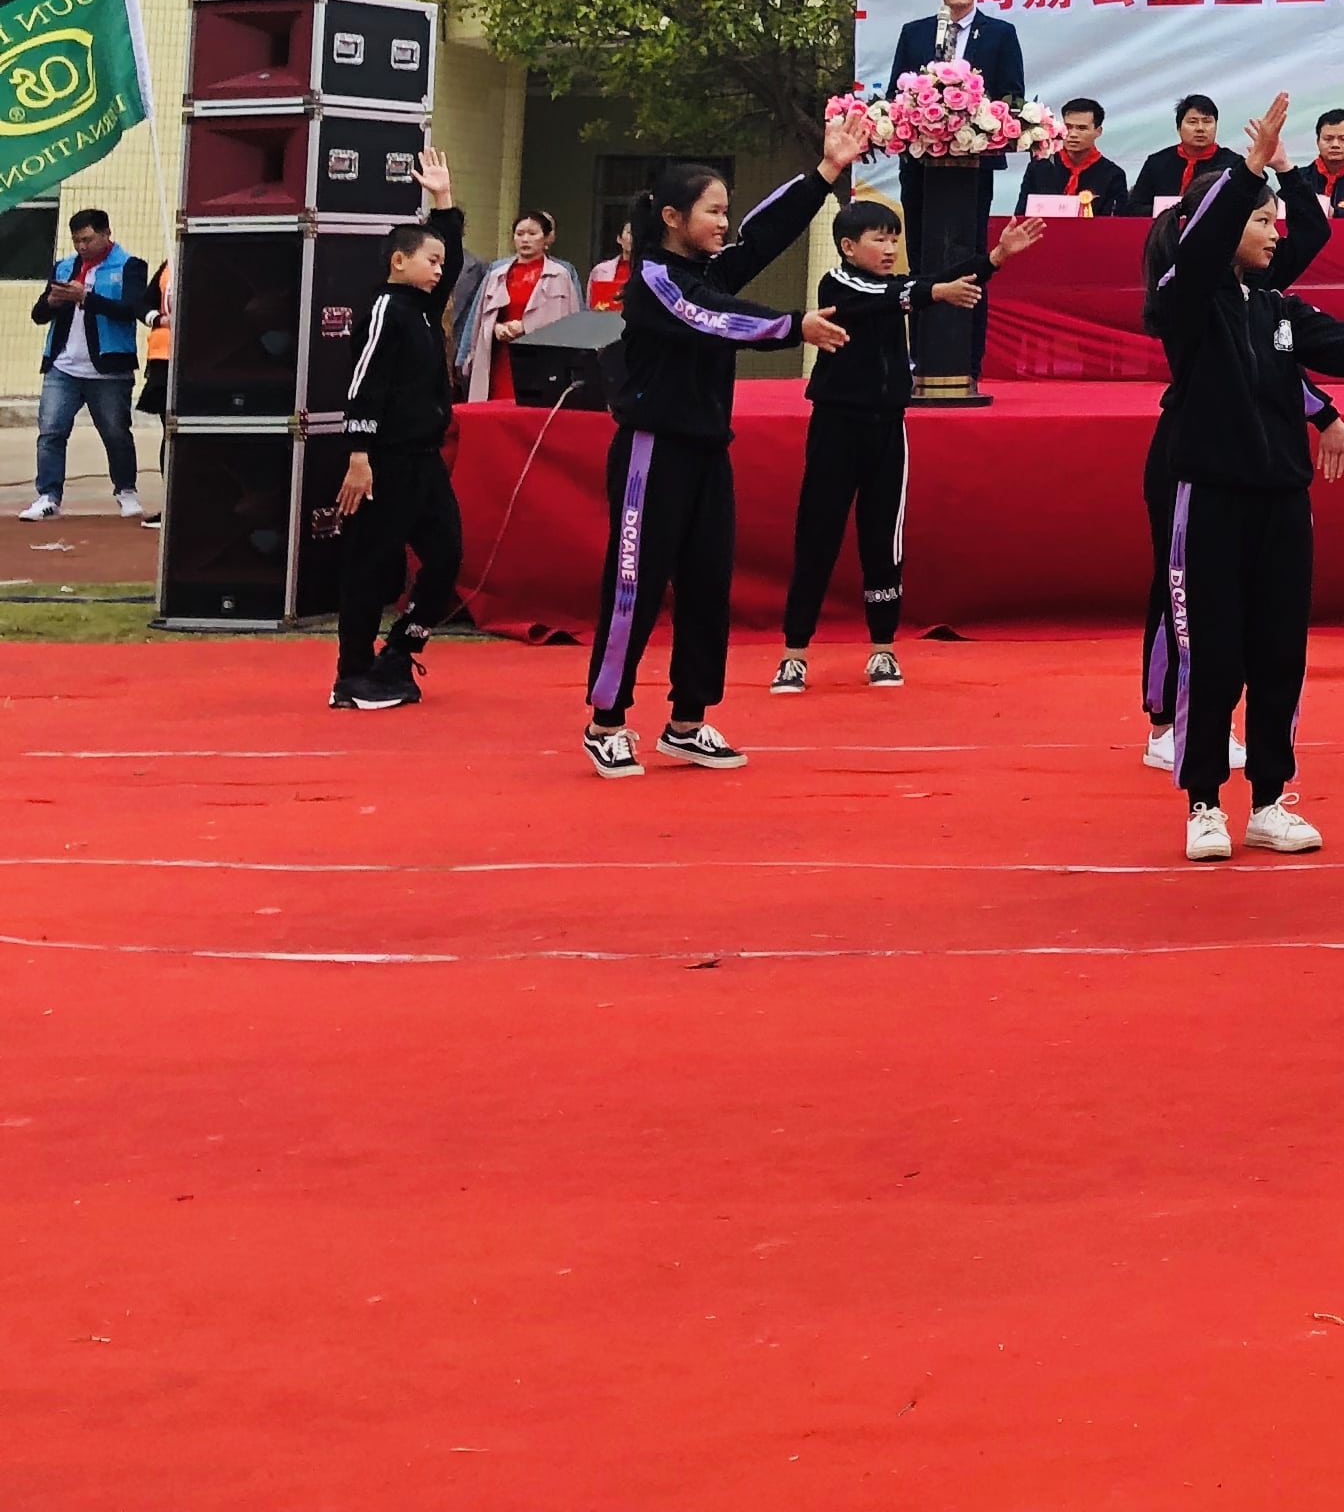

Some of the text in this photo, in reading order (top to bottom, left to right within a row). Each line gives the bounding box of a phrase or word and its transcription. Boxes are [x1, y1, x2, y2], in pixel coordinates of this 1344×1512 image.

[674, 299, 730, 329] DCANE
[621, 509, 639, 580] DCANE
[1170, 569, 1190, 650] DCANE
